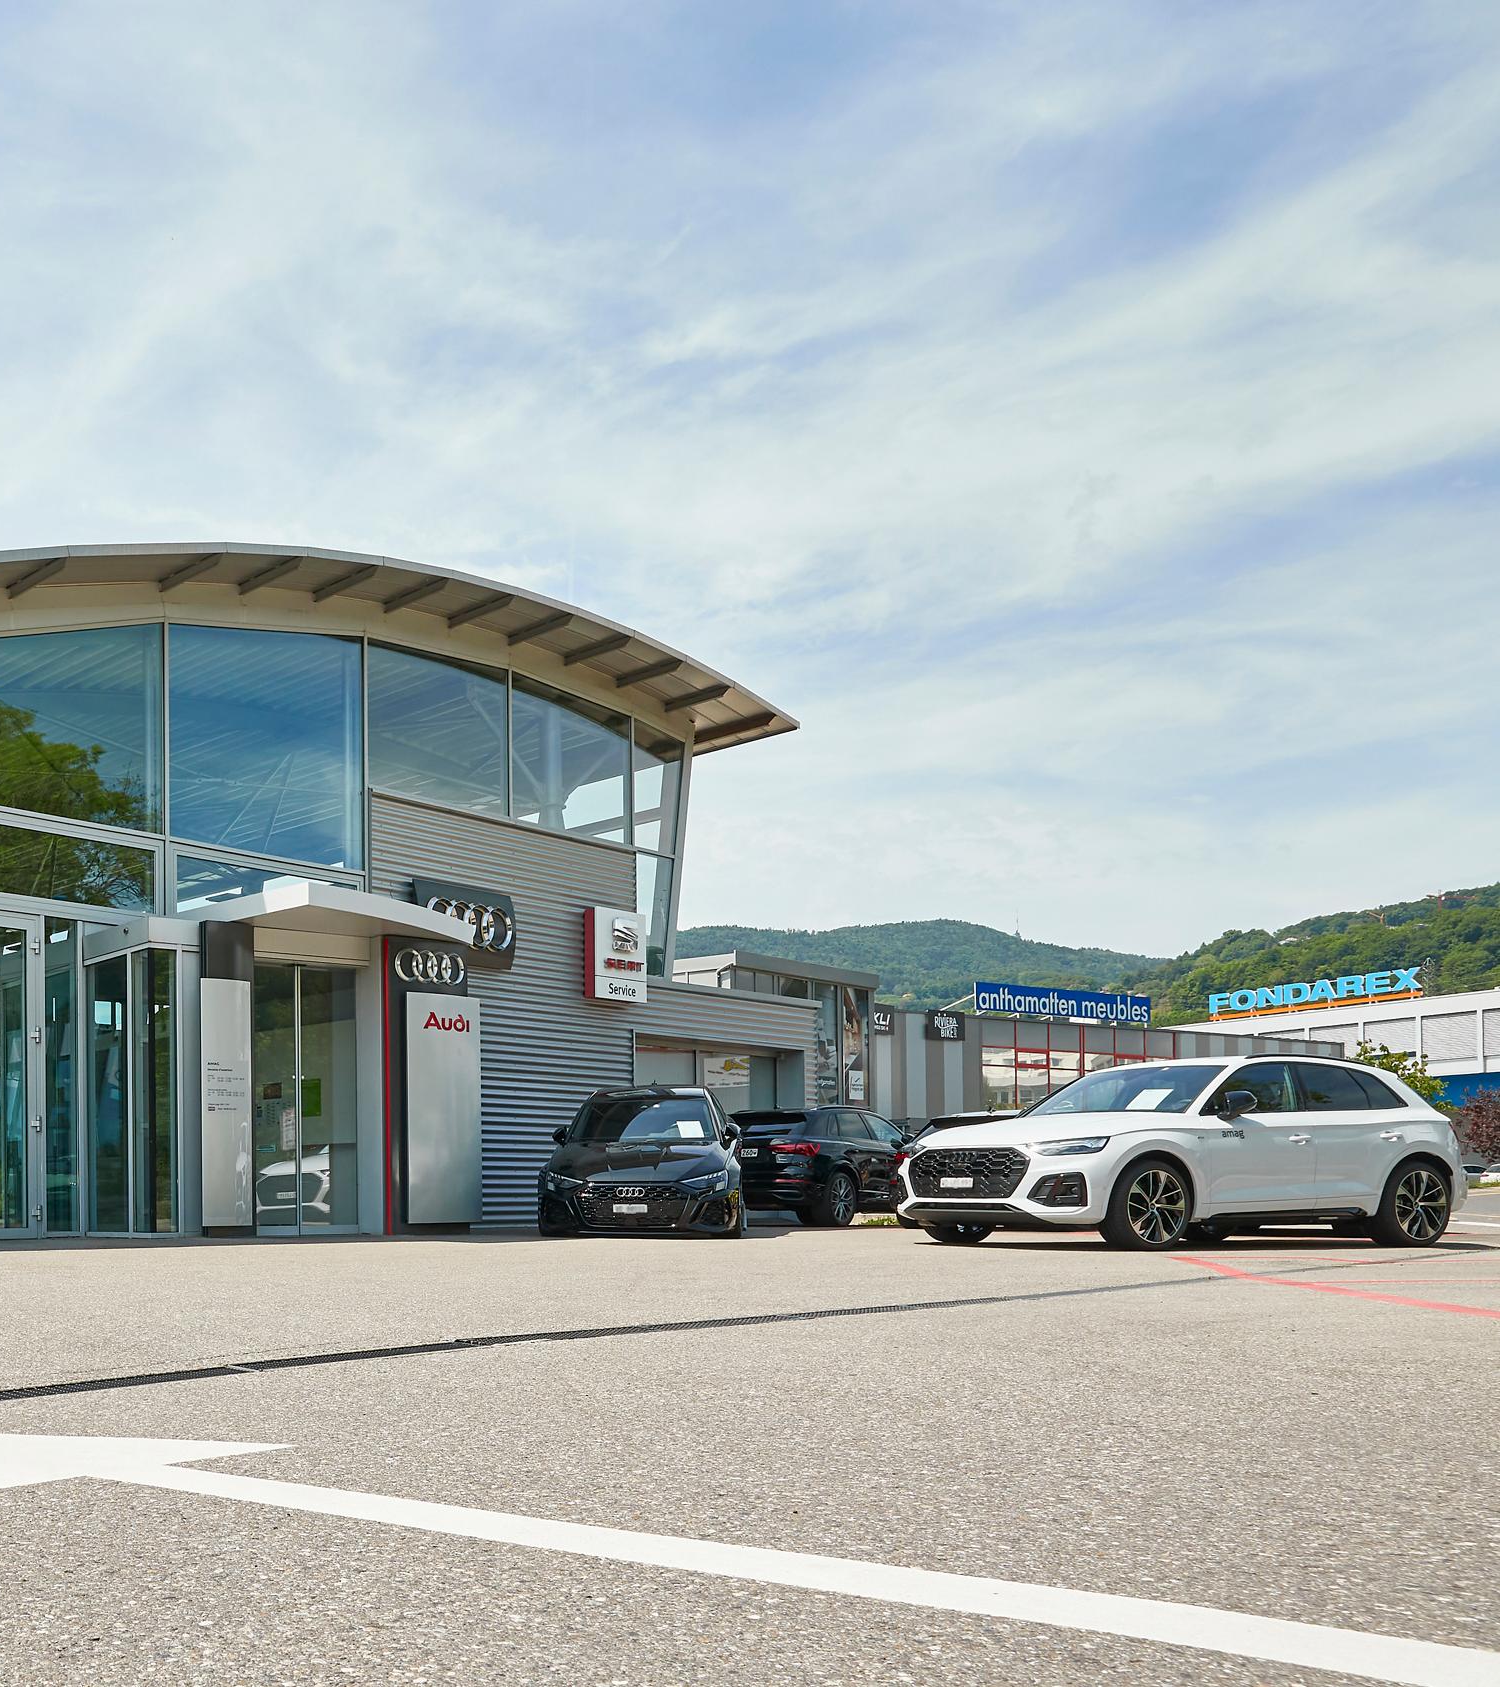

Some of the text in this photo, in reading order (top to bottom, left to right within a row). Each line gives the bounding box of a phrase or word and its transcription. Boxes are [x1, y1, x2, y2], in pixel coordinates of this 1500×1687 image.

[603, 957, 645, 973] SEAT
[608, 982, 637, 998] Service
[1208, 966, 1423, 1014] FONDAREX
[978, 987, 1148, 1022] anthamatten meubles
[423, 1011, 470, 1033] Audi
[1221, 1129, 1246, 1139] amag
